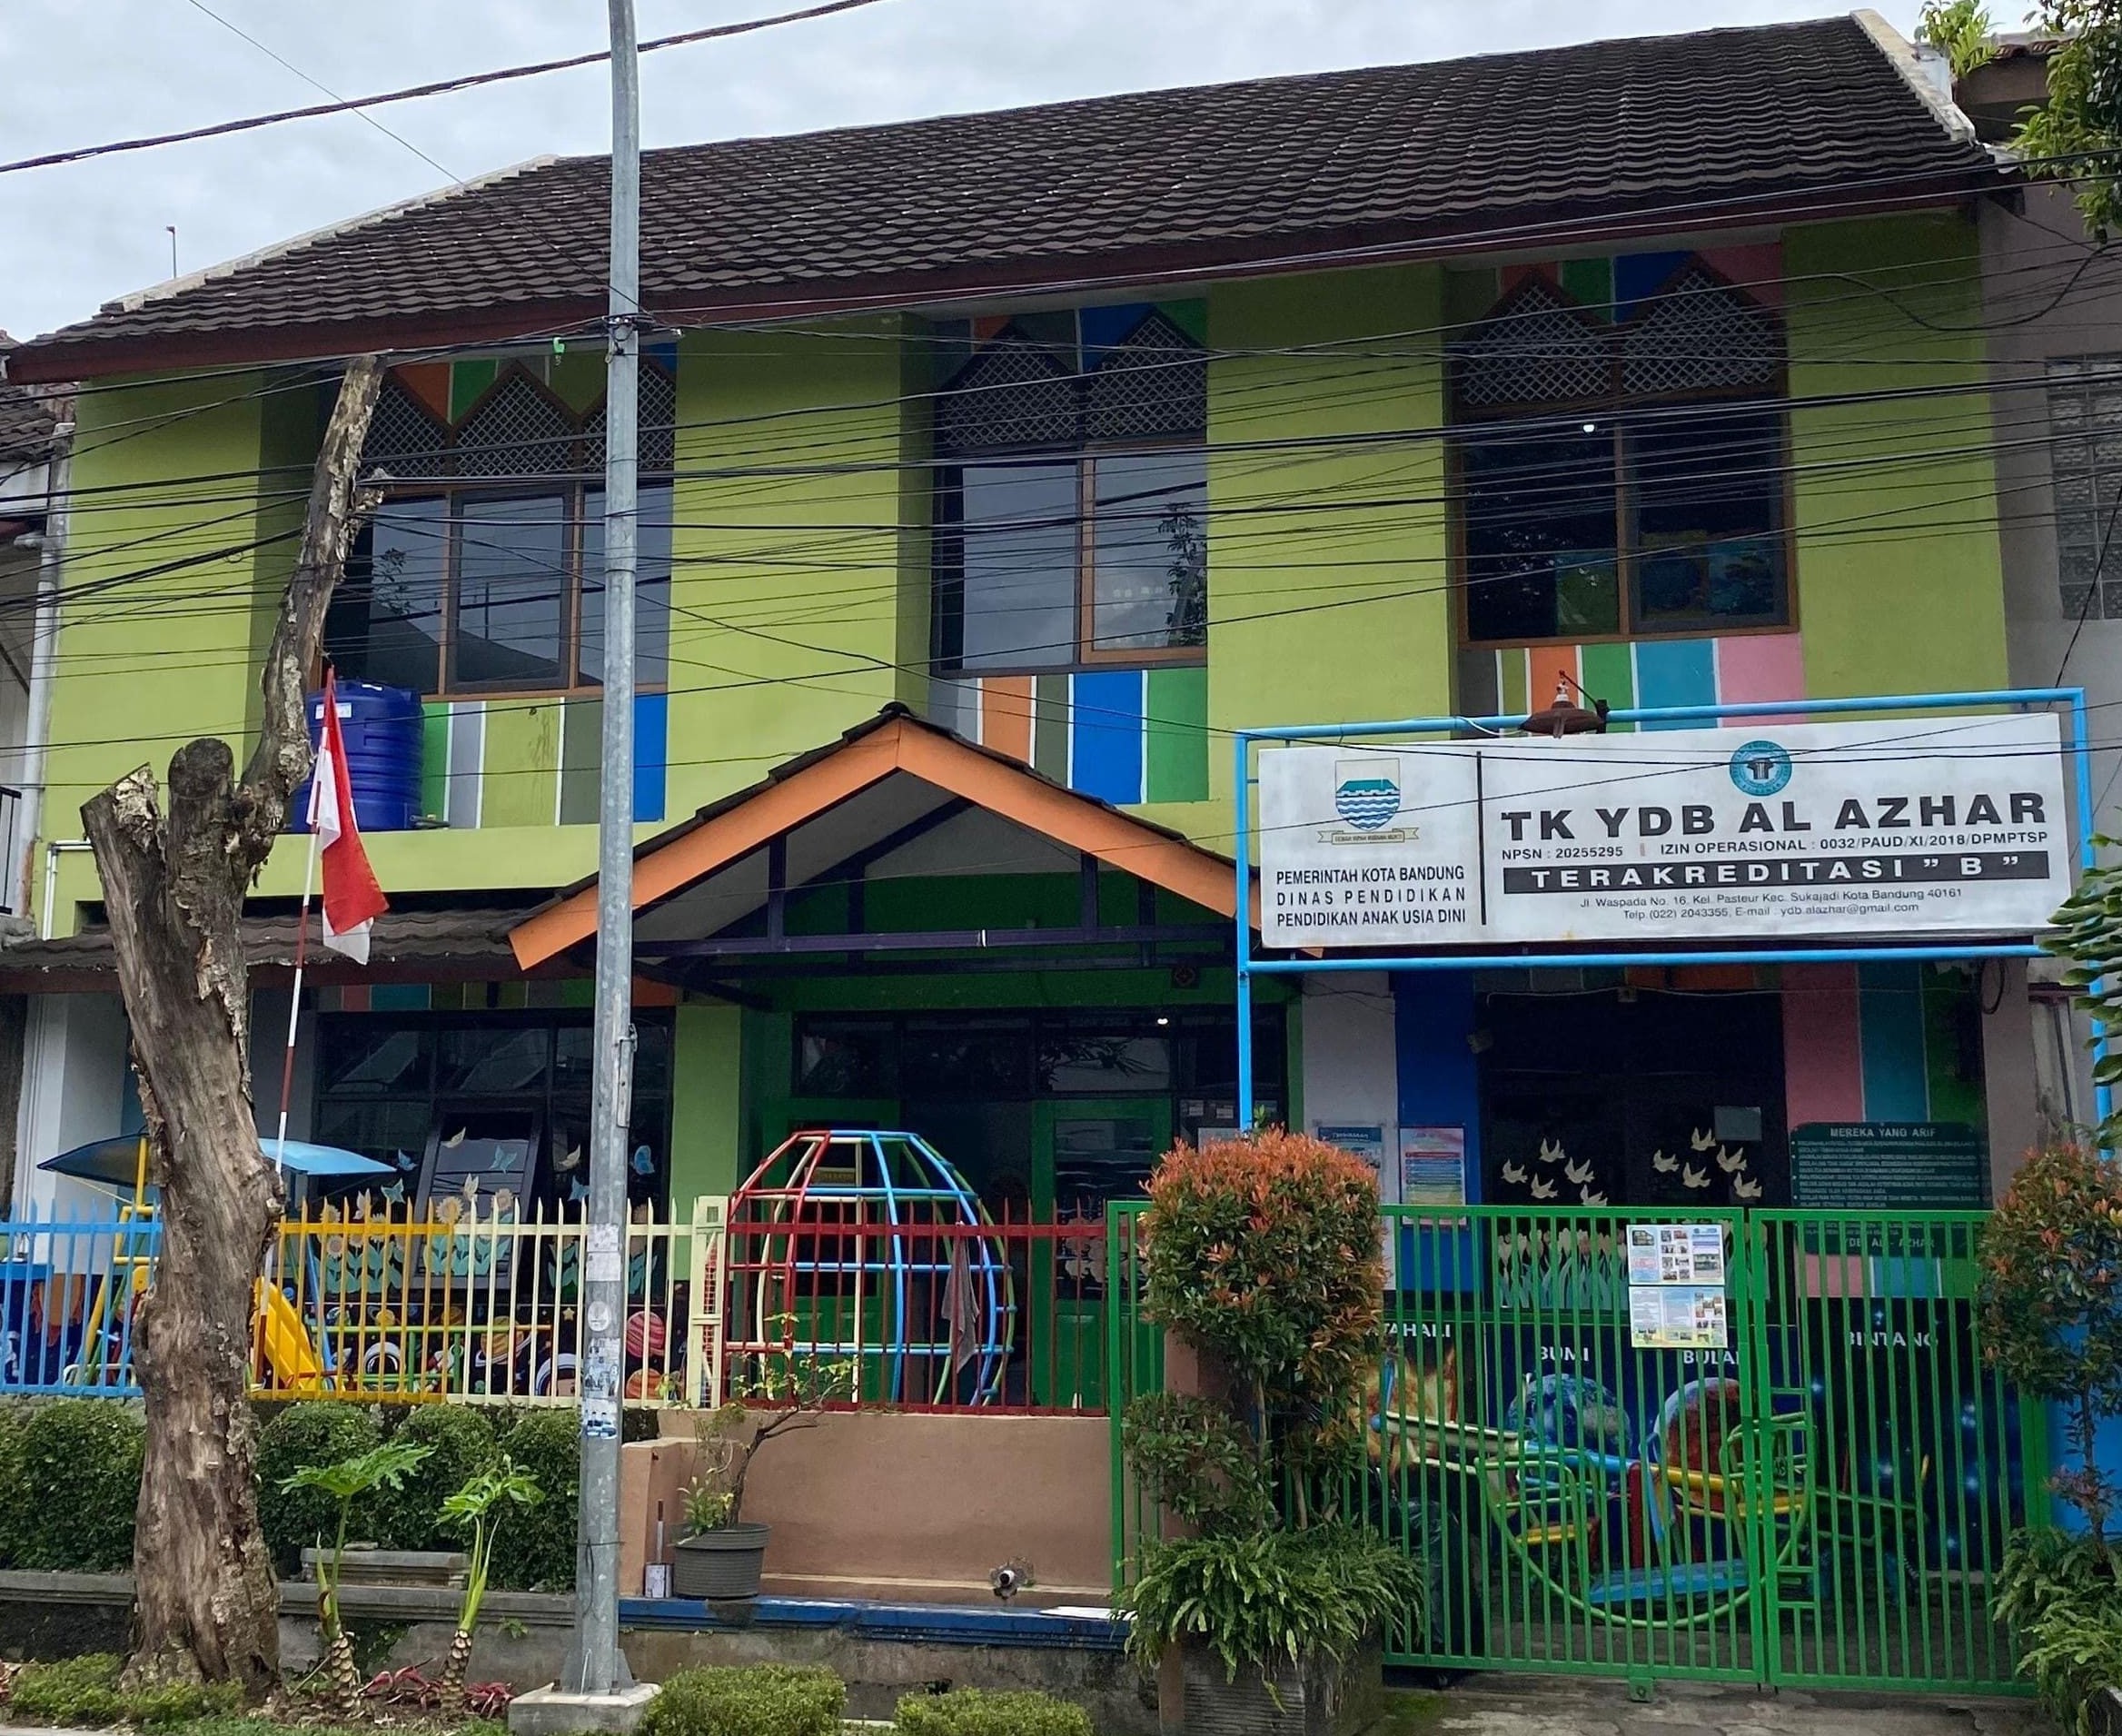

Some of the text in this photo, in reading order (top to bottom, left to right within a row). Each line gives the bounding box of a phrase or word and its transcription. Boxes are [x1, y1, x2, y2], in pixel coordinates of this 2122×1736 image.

[1501, 792, 2046, 841] TK YDB AL AZHAR
[1502, 848, 1542, 860] NPSN
[1555, 845, 1623, 858] 20255295
[1661, 843, 1690, 856] IZIN
[1695, 838, 1807, 854] OPERASIONAL
[1820, 831, 2048, 849] 0032/PAUD/XI/2018/DPMPTSP
[1276, 865, 1464, 885] PEMERINTAH KOTA BANDUNG
[1531, 858, 1902, 889] TERAKREDITASI
[1960, 857, 1982, 876] B
[1276, 887, 1465, 907] DINAS PENDIDIKAN
[1595, 897, 1647, 911] Waspada
[1717, 893, 1759, 905] Pasteur
[1790, 890, 1839, 904] Sukajadi
[1843, 889, 1869, 901] Kota
[1872, 888, 1924, 901] Bandung
[1927, 888, 1962, 898] 40161
[1277, 908, 1466, 927] PENDIDIKAN ANAK USIA DINI
[1735, 906, 1770, 917] E-mail
[1830, 1127, 1936, 1137] MEREKA YANG ARIF
